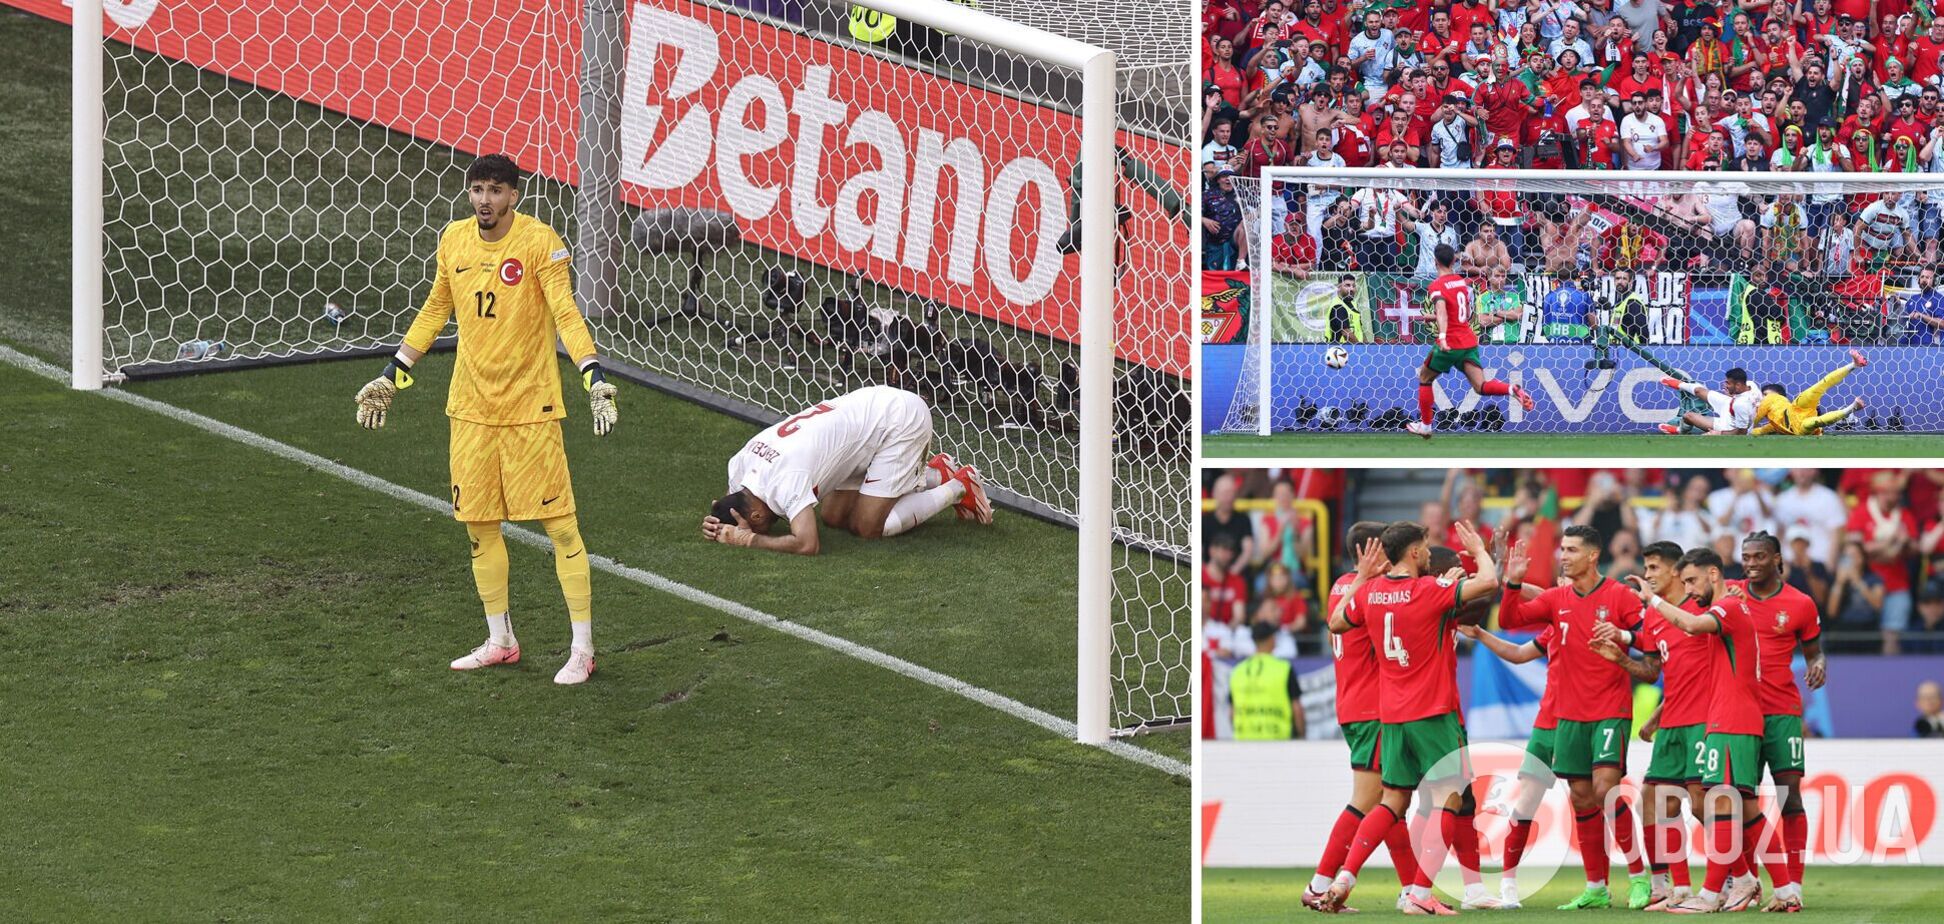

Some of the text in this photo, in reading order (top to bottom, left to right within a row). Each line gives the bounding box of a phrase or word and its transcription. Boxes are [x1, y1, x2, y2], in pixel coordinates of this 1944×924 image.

[620, 3, 1068, 307] Betano
[474, 290, 496, 319] 12
[1457, 291, 1467, 323] 8
[1552, 322, 1570, 337] HB
[1383, 611, 1409, 667] 4
[1559, 622, 1569, 646] 7
[1602, 728, 1615, 751] 7
[1787, 735, 1804, 760] 17
[1707, 748, 1720, 772] 8
